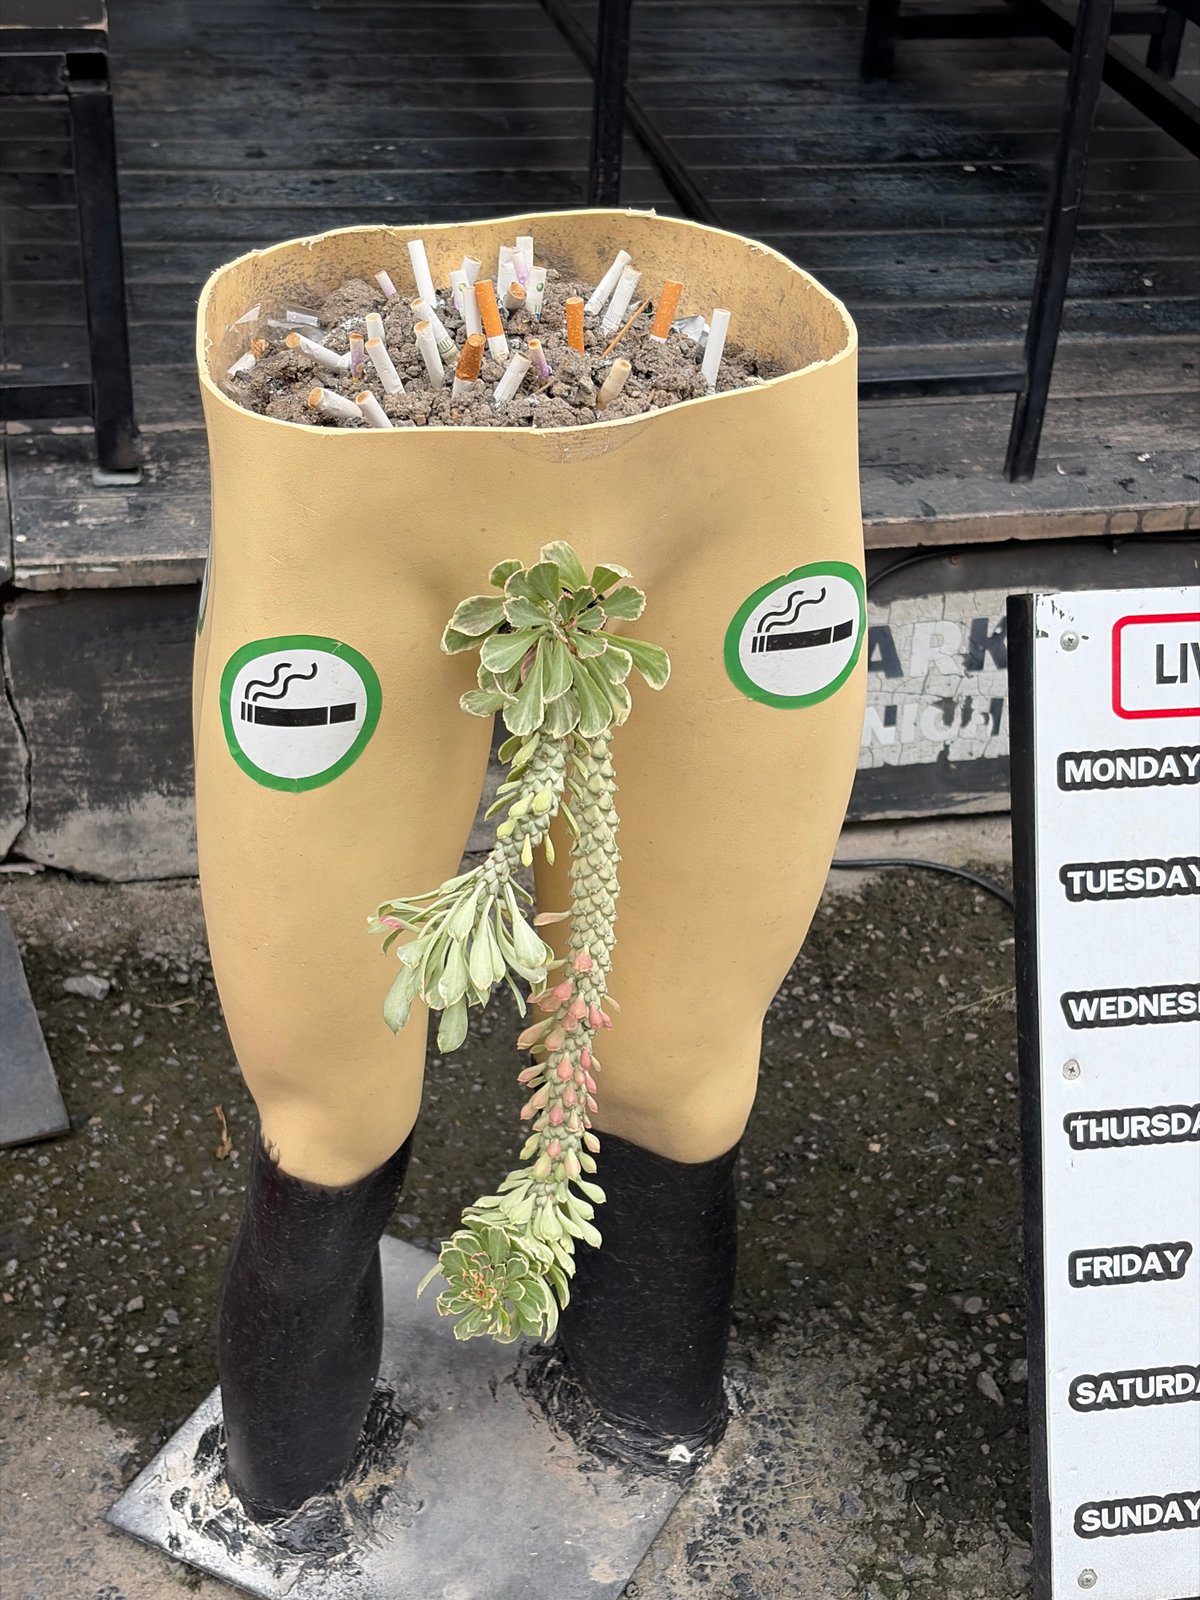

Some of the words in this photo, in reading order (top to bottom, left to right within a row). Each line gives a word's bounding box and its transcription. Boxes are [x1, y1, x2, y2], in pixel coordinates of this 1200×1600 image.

[1065, 753, 1200, 783] MONDAY
[1068, 991, 1200, 1022] WEDNES
[1076, 1249, 1185, 1281] FRIDAY
[1076, 1372, 1200, 1405] SATURD
[1081, 1498, 1200, 1532] SUNDAY
